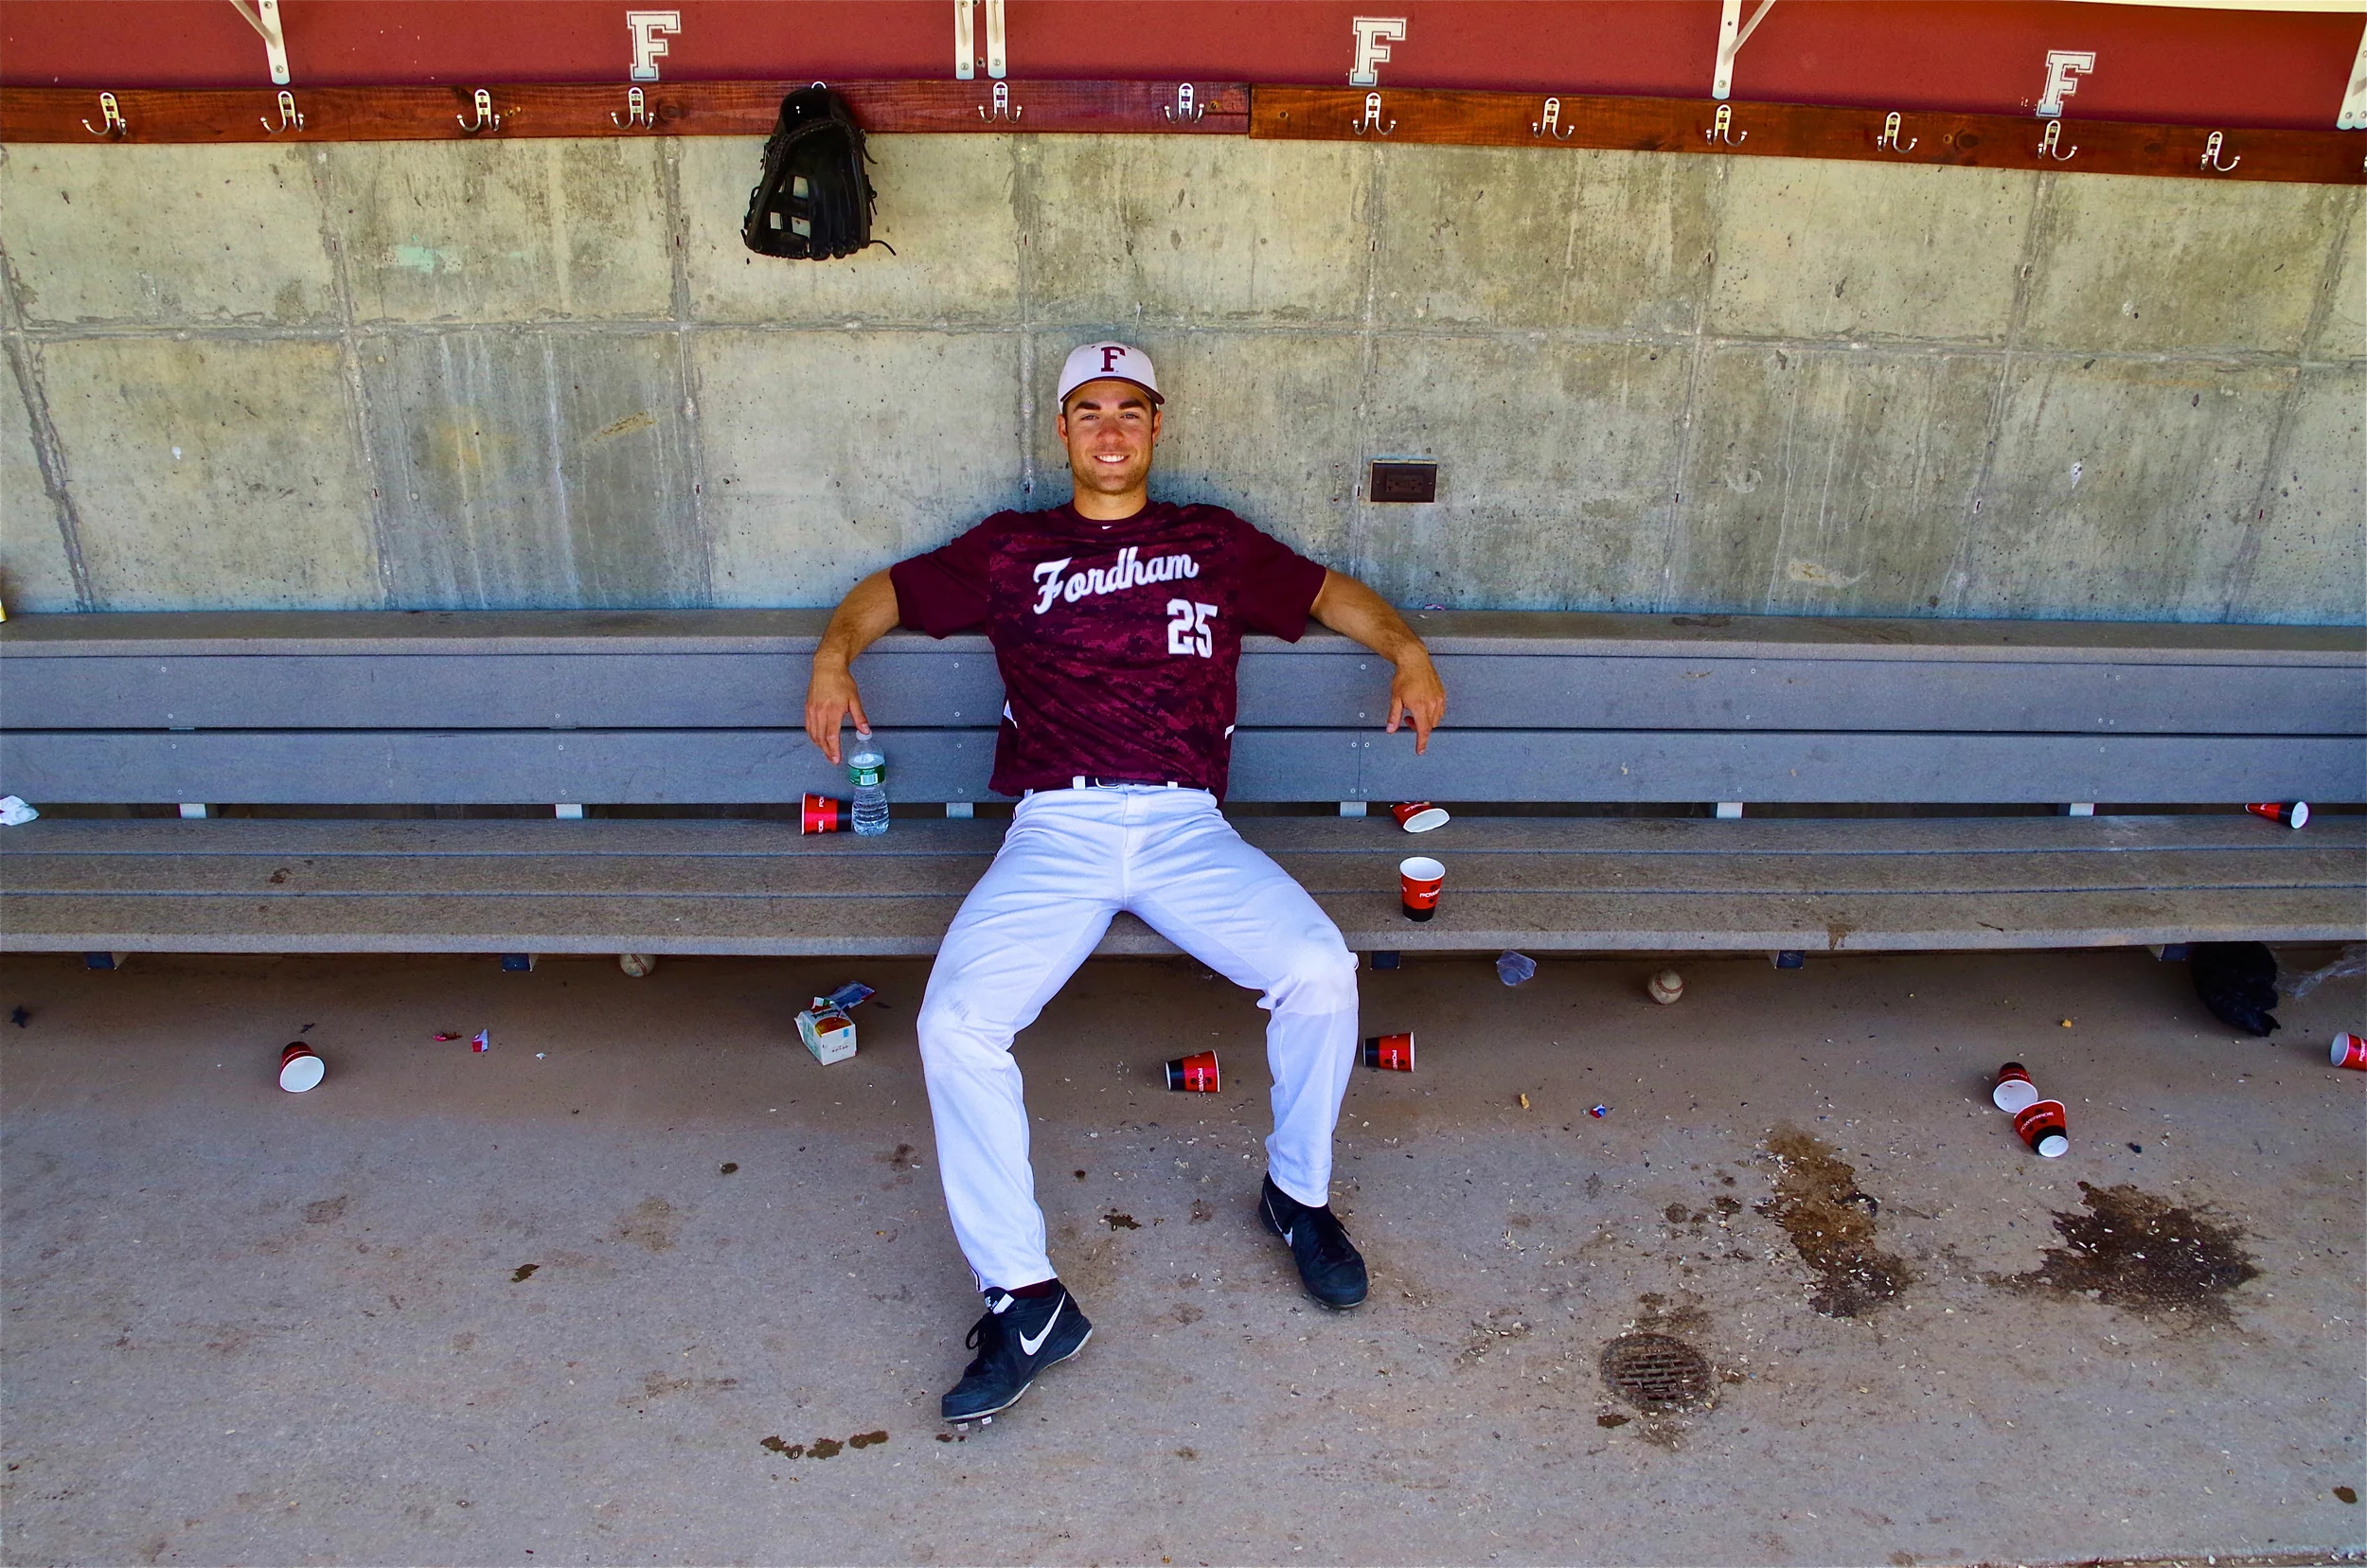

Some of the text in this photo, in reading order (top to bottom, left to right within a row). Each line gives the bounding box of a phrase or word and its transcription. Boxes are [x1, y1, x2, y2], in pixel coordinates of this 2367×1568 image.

[626, 10, 681, 81] F
[1349, 16, 1407, 87] F
[2036, 50, 2096, 117] F
[1100, 346, 1126, 372] F
[1033, 546, 1199, 615] Fordham
[1166, 598, 1218, 658] 25
